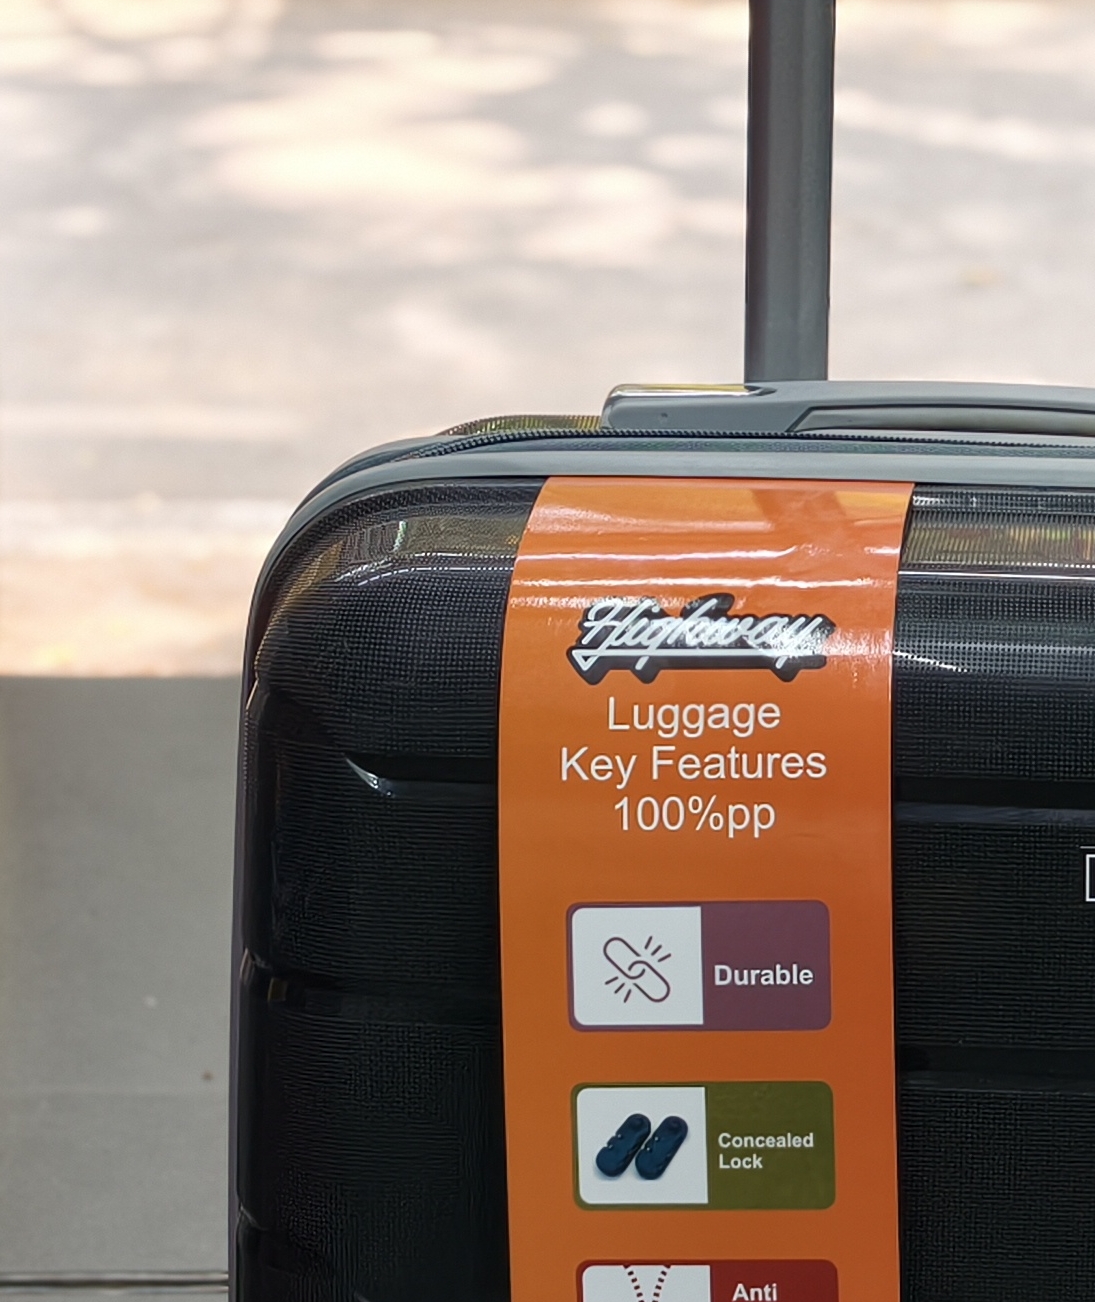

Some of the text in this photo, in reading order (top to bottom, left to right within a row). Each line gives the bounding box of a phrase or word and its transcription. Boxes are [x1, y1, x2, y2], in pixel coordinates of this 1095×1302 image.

[607, 697, 782, 738] Luggage
[560, 745, 828, 789] Key Features
[614, 795, 777, 839] 100%pp
[713, 963, 815, 987] Durable
[717, 1132, 815, 1149] Concealed
[718, 1154, 764, 1170] Lock
[732, 1283, 778, 1302] Anti
